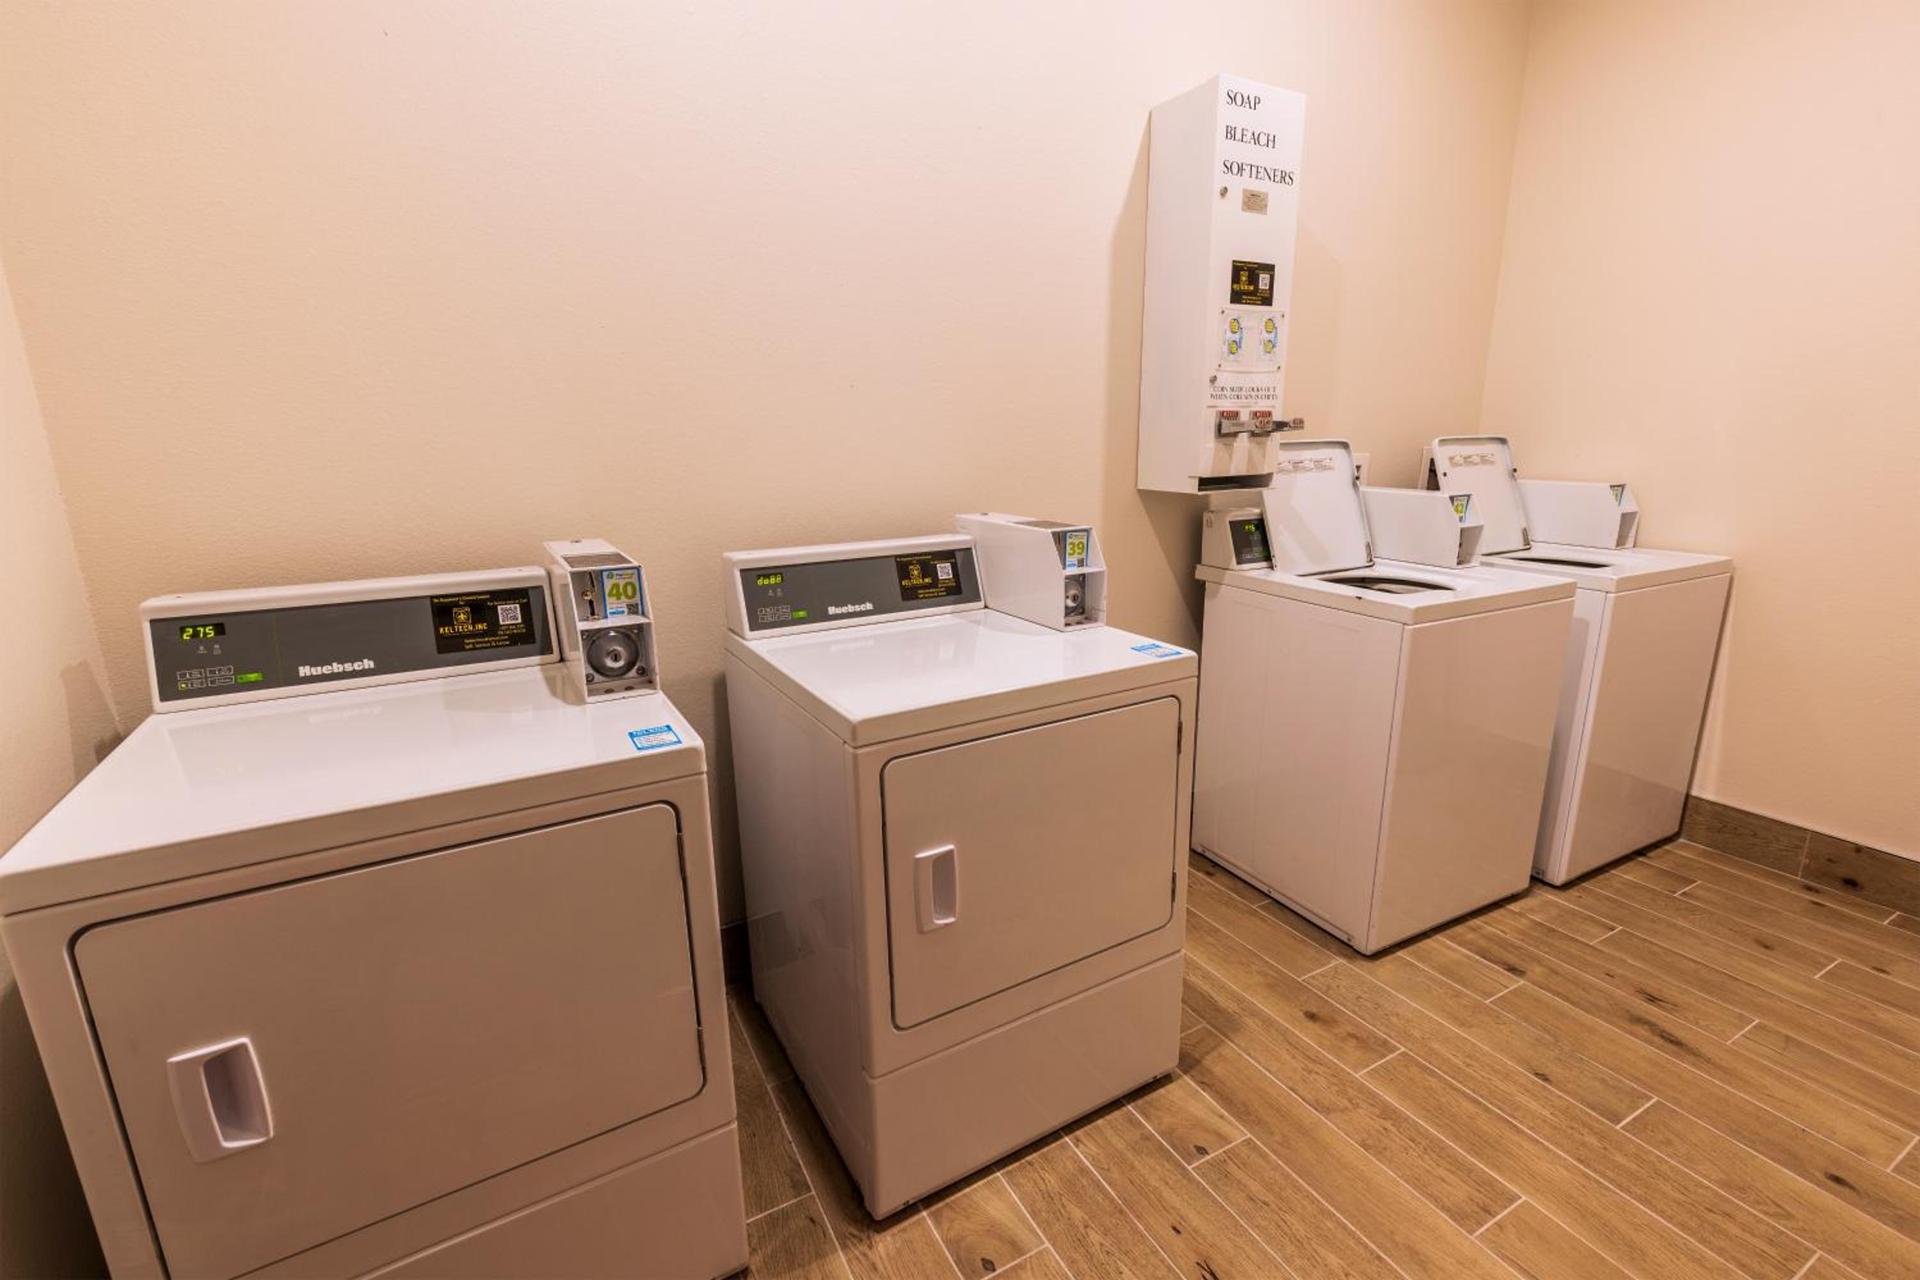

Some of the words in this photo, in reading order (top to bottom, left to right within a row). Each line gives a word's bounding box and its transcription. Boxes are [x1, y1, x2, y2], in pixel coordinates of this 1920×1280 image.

[1226, 89, 1261, 111] SOAP
[1225, 125, 1276, 149] BLEACH
[1222, 159, 1294, 186] SOFTENERS
[1068, 541, 1085, 556] 39
[608, 581, 637, 600] 40
[827, 601, 874, 615] Huebsch
[183, 626, 215, 640] 275
[297, 658, 375, 677] Huebsch
